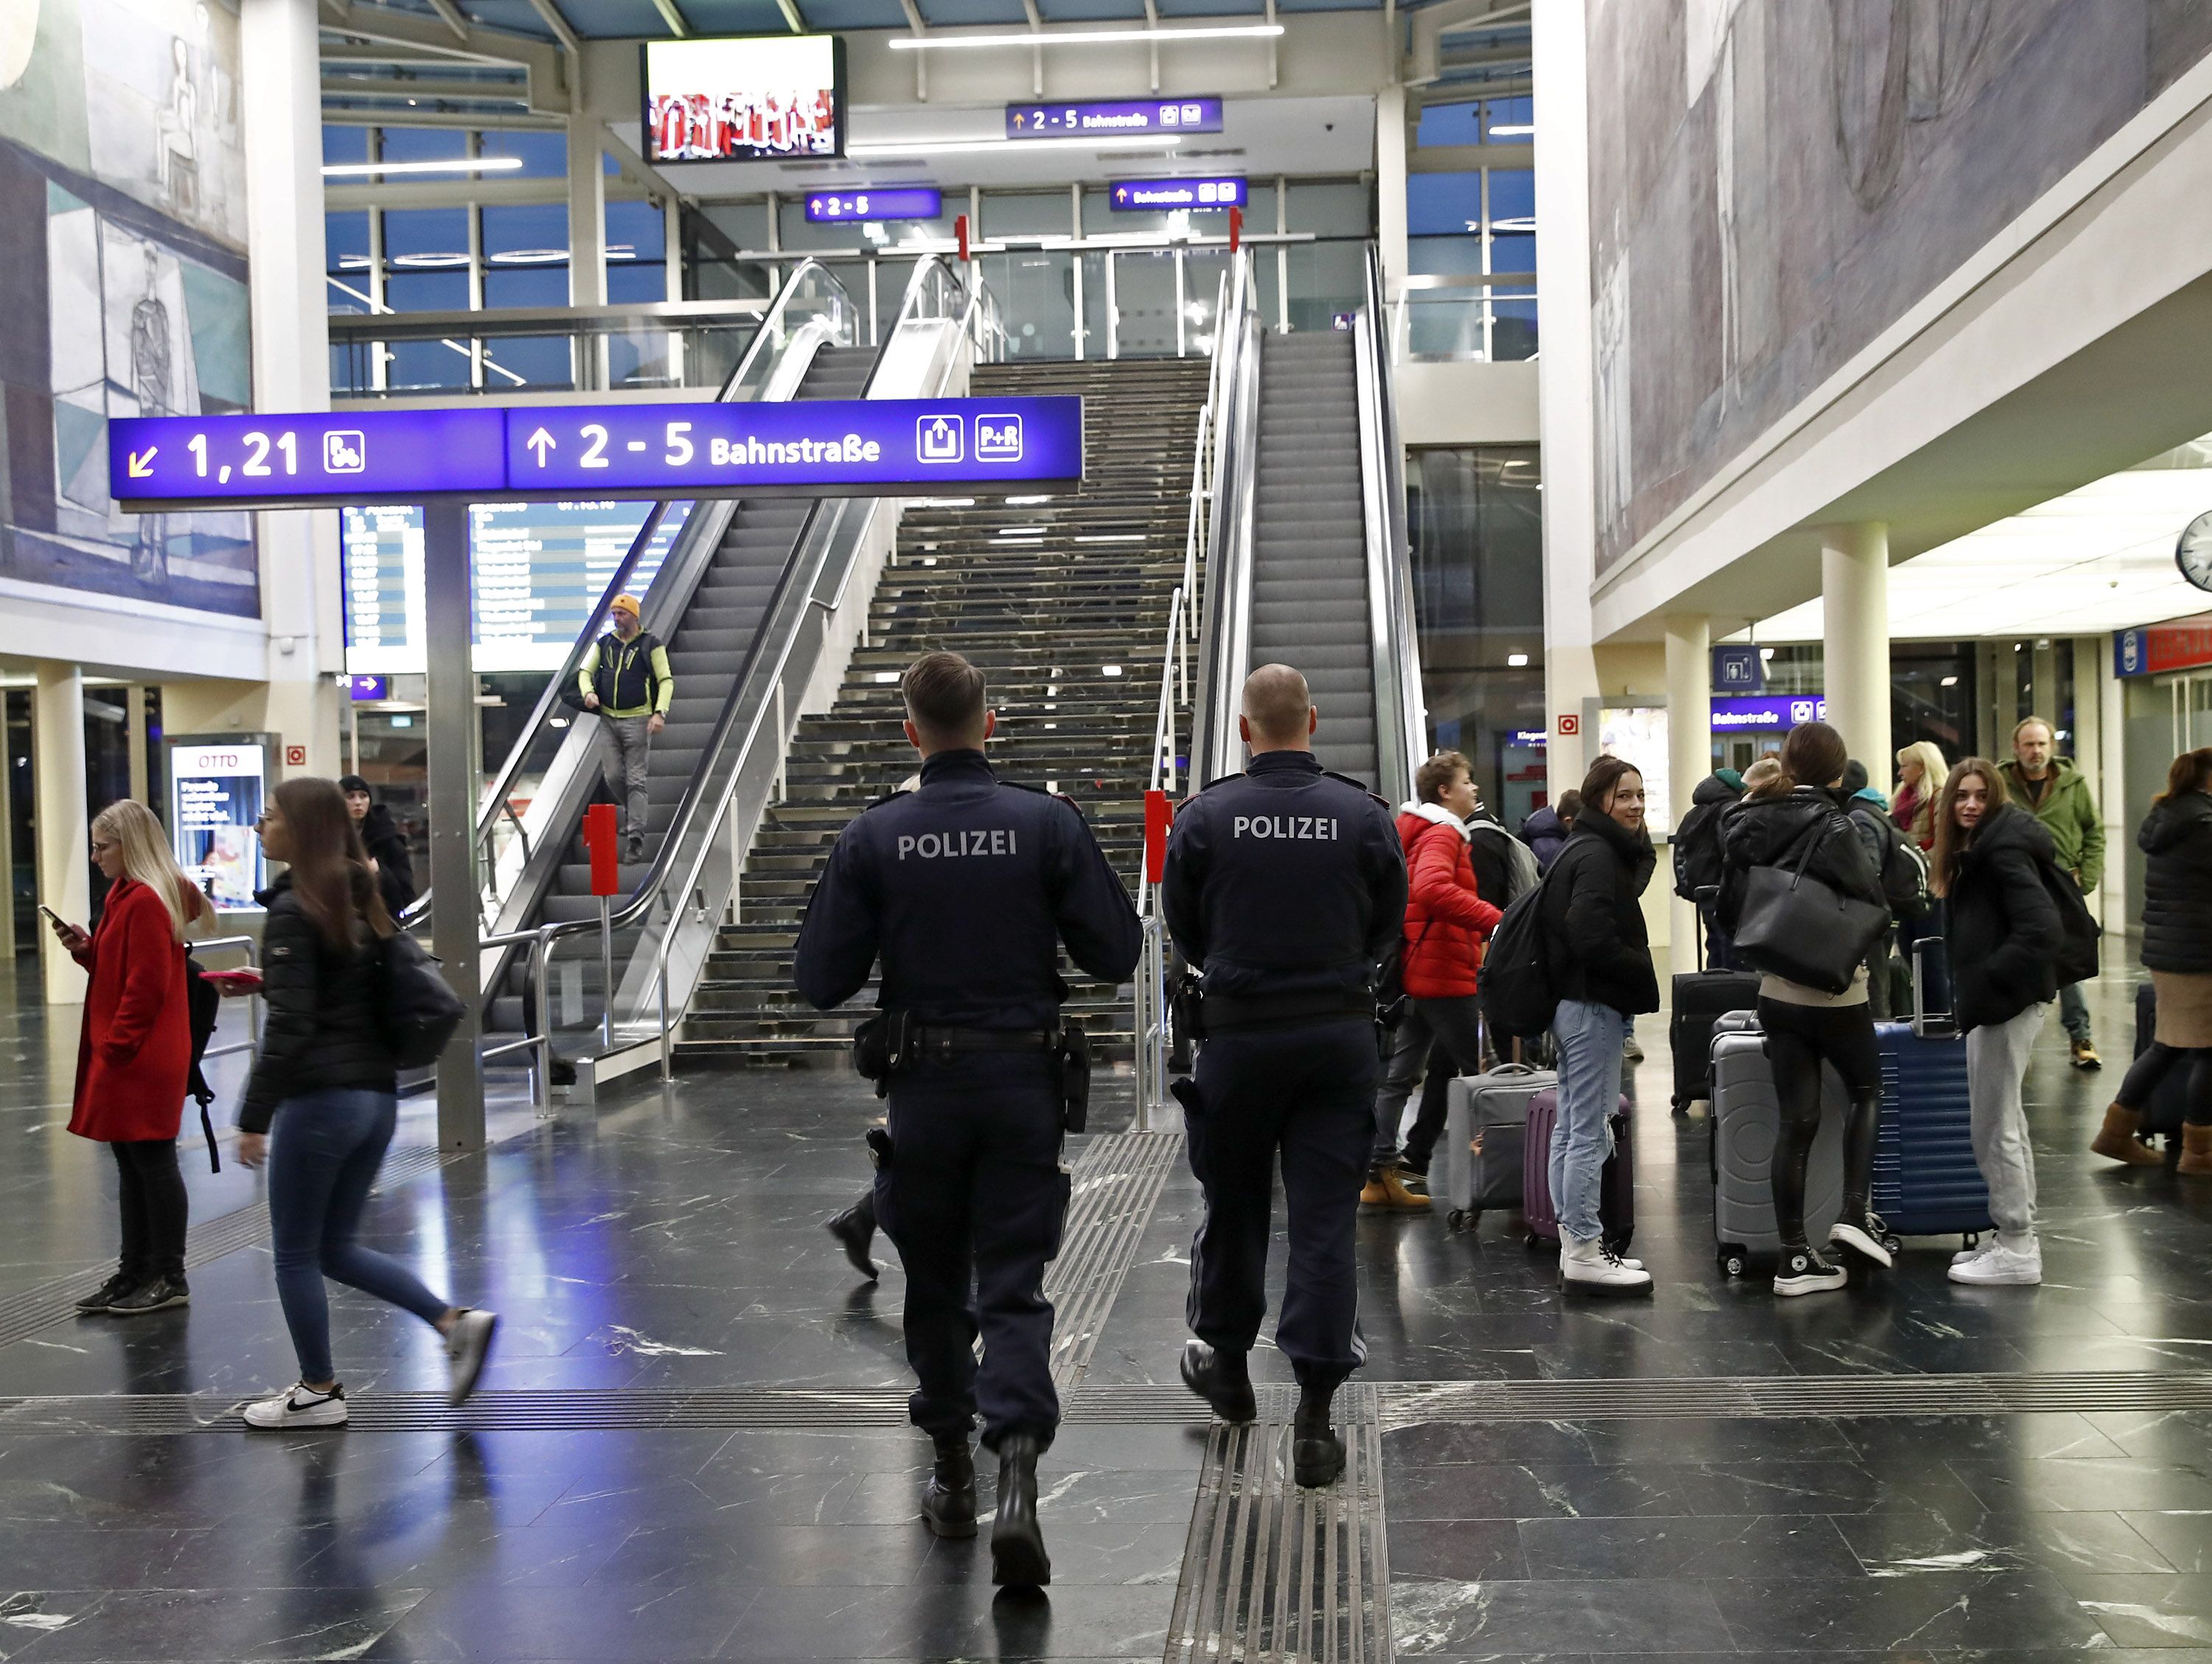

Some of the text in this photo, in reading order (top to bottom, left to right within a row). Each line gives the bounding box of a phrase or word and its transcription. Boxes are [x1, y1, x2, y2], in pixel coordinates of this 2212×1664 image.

[1032, 111, 1046, 130] 2
[1065, 109, 1078, 129] 5
[1082, 112, 1149, 129] Bahnstraße
[827, 195, 869, 215] 2 - 5
[580, 424, 610, 468] 2
[627, 440, 647, 452] -
[664, 422, 695, 467] 5
[709, 434, 880, 466] Bahnstraße
[187, 431, 298, 484] 1,21
[1711, 711, 1779, 725] Bahnstraße
[198, 754, 238, 768] OTTO
[1234, 815, 1338, 841] POLIZEI
[897, 829, 1017, 860] POLIZEI
